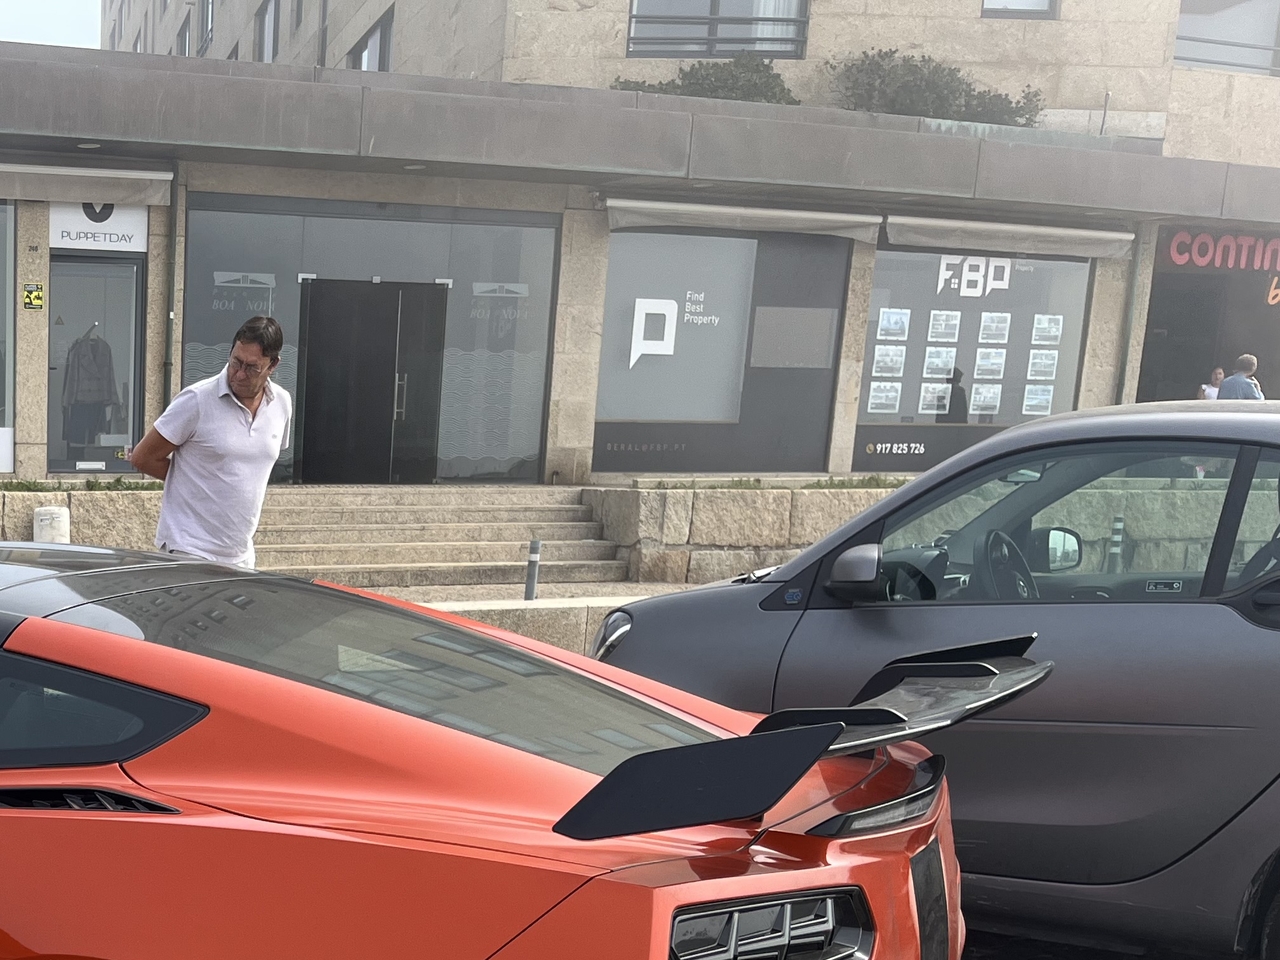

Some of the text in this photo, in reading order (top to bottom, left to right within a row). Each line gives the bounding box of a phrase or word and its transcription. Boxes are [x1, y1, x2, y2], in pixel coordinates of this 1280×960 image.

[61, 230, 135, 244] PUPPETDAY
[686, 291, 705, 301] Find
[211, 299, 235, 311] BOA
[685, 302, 704, 312] Best
[684, 313, 720, 326] Property
[876, 443, 925, 454] 917 825 726
